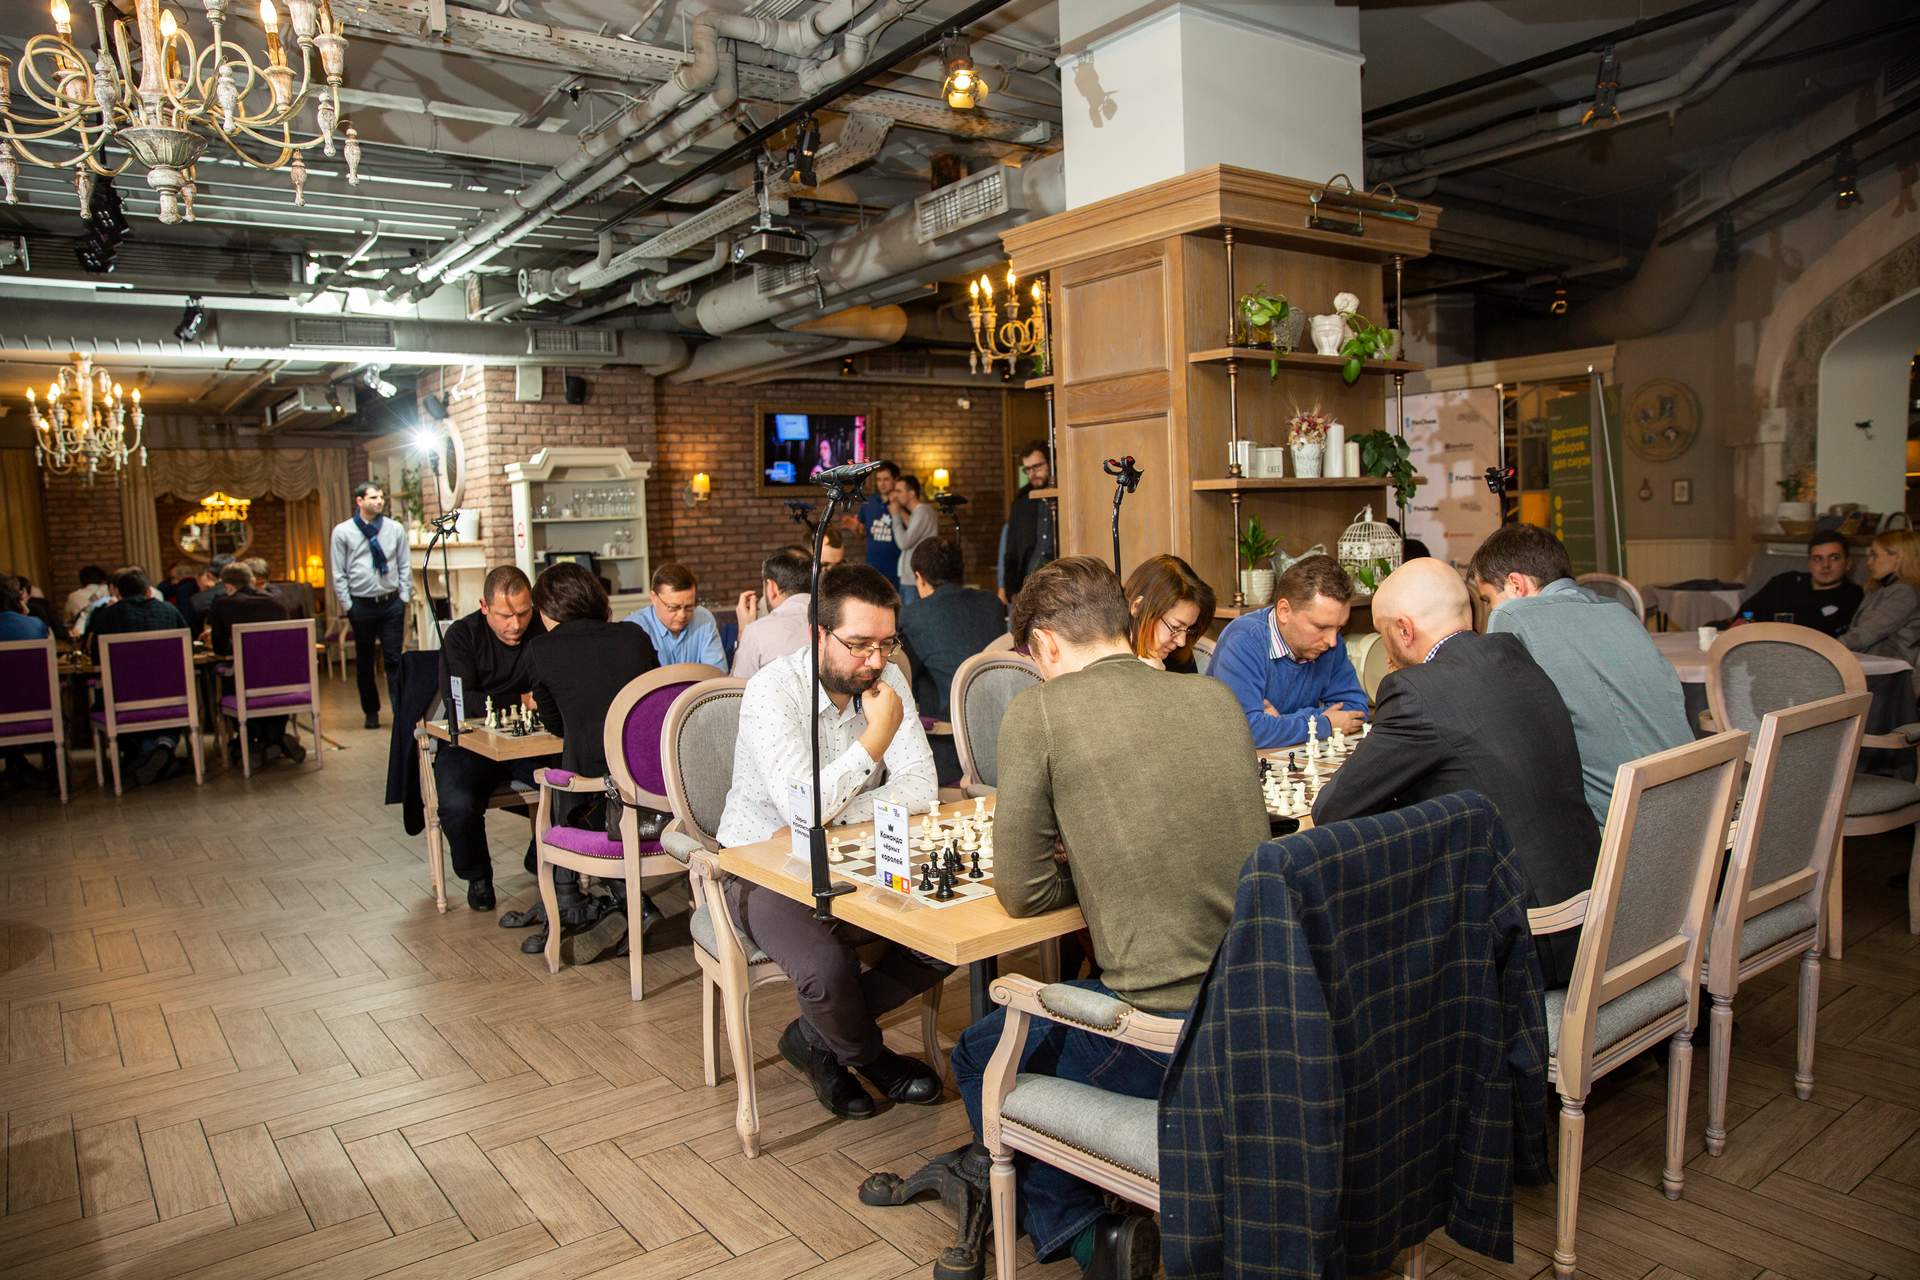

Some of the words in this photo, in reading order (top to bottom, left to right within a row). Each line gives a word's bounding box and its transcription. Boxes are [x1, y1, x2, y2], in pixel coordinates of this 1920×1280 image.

[880, 830, 903, 844] Команда
[883, 842, 900, 853] чёрных
[881, 853, 903, 866] королей
